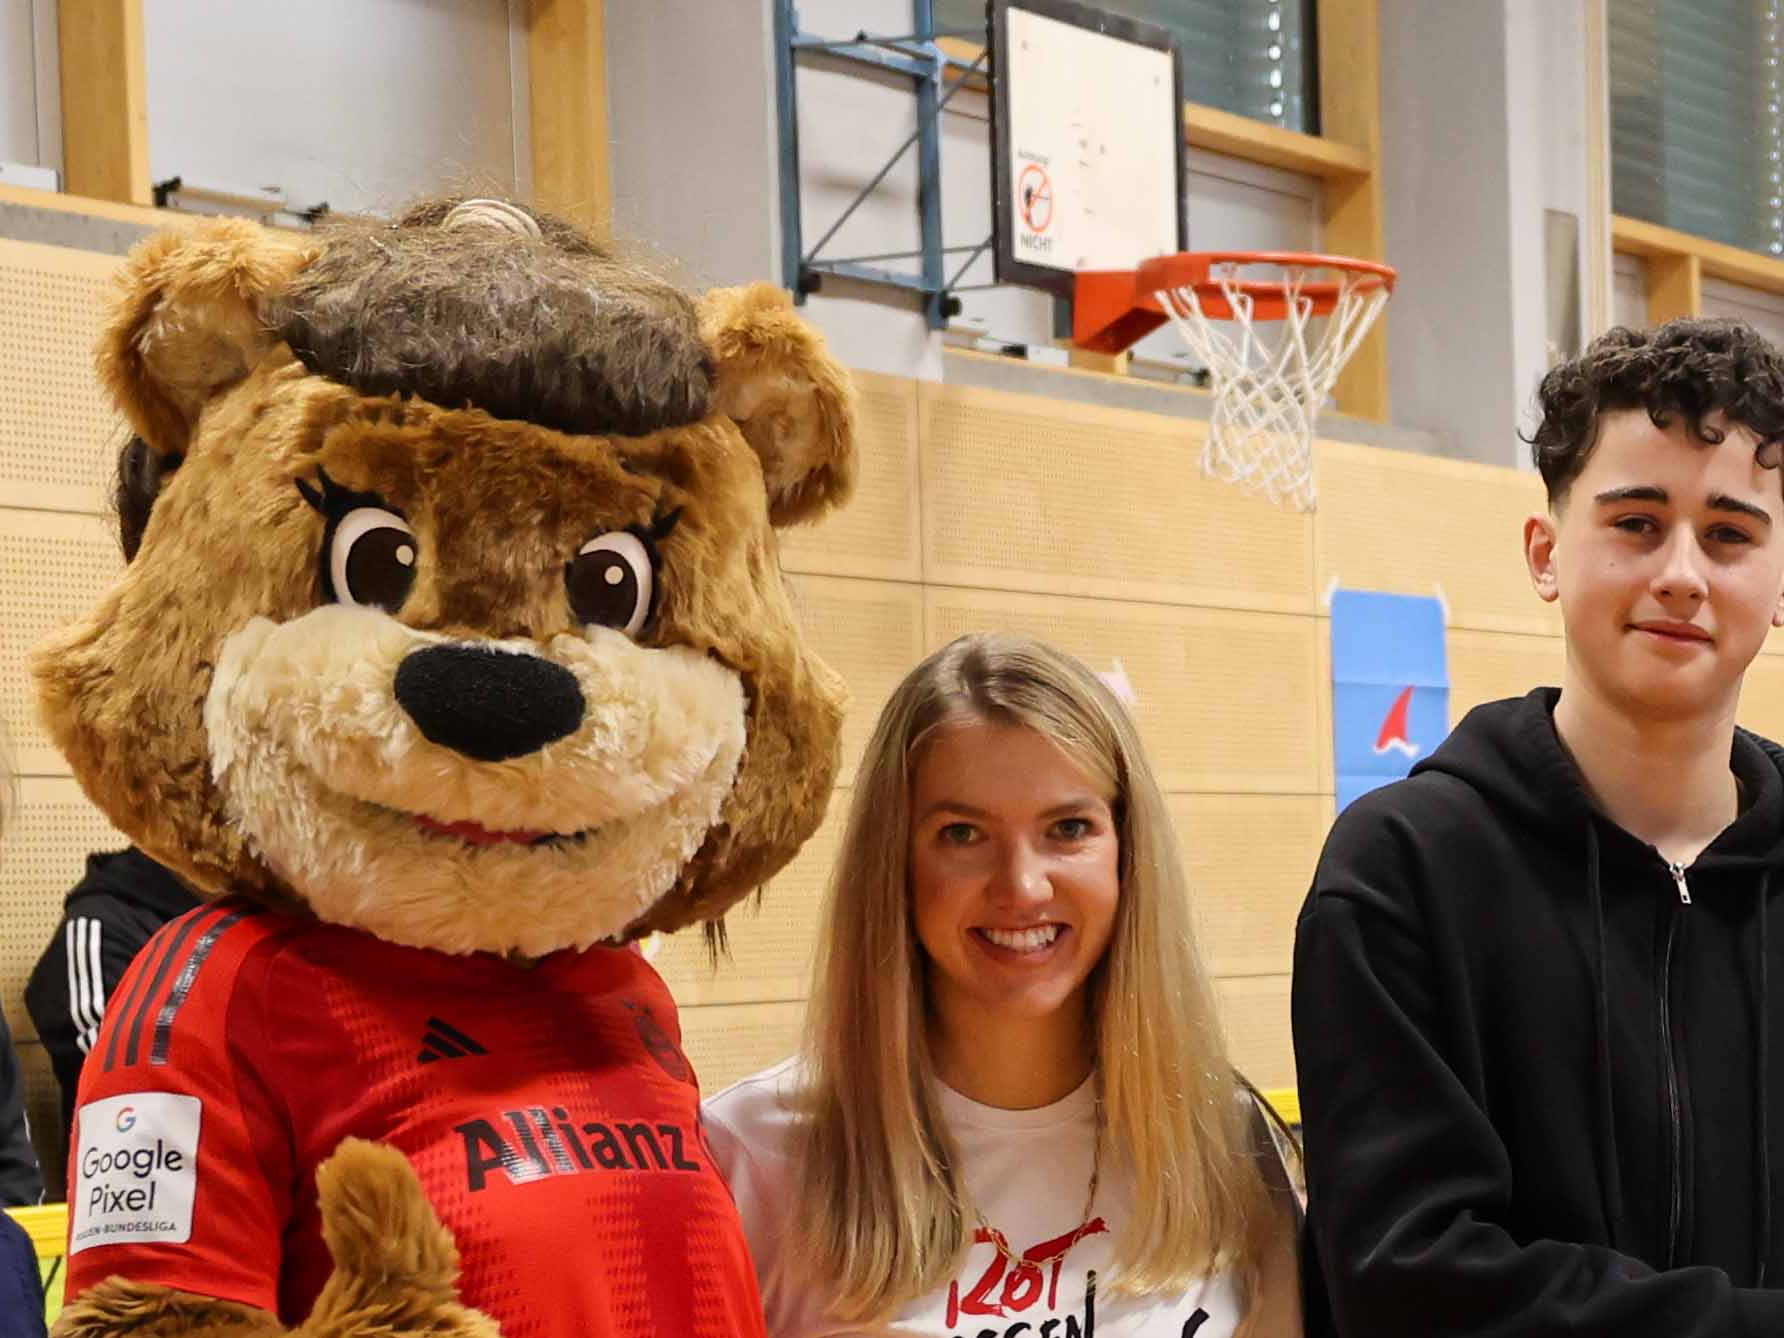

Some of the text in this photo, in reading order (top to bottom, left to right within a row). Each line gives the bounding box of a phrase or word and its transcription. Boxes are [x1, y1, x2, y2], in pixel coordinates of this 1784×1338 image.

[82, 1138, 183, 1179] Google
[453, 1105, 701, 1193] Allianz
[88, 1180, 157, 1217] Pixel
[945, 1217, 1111, 1329] ROT
